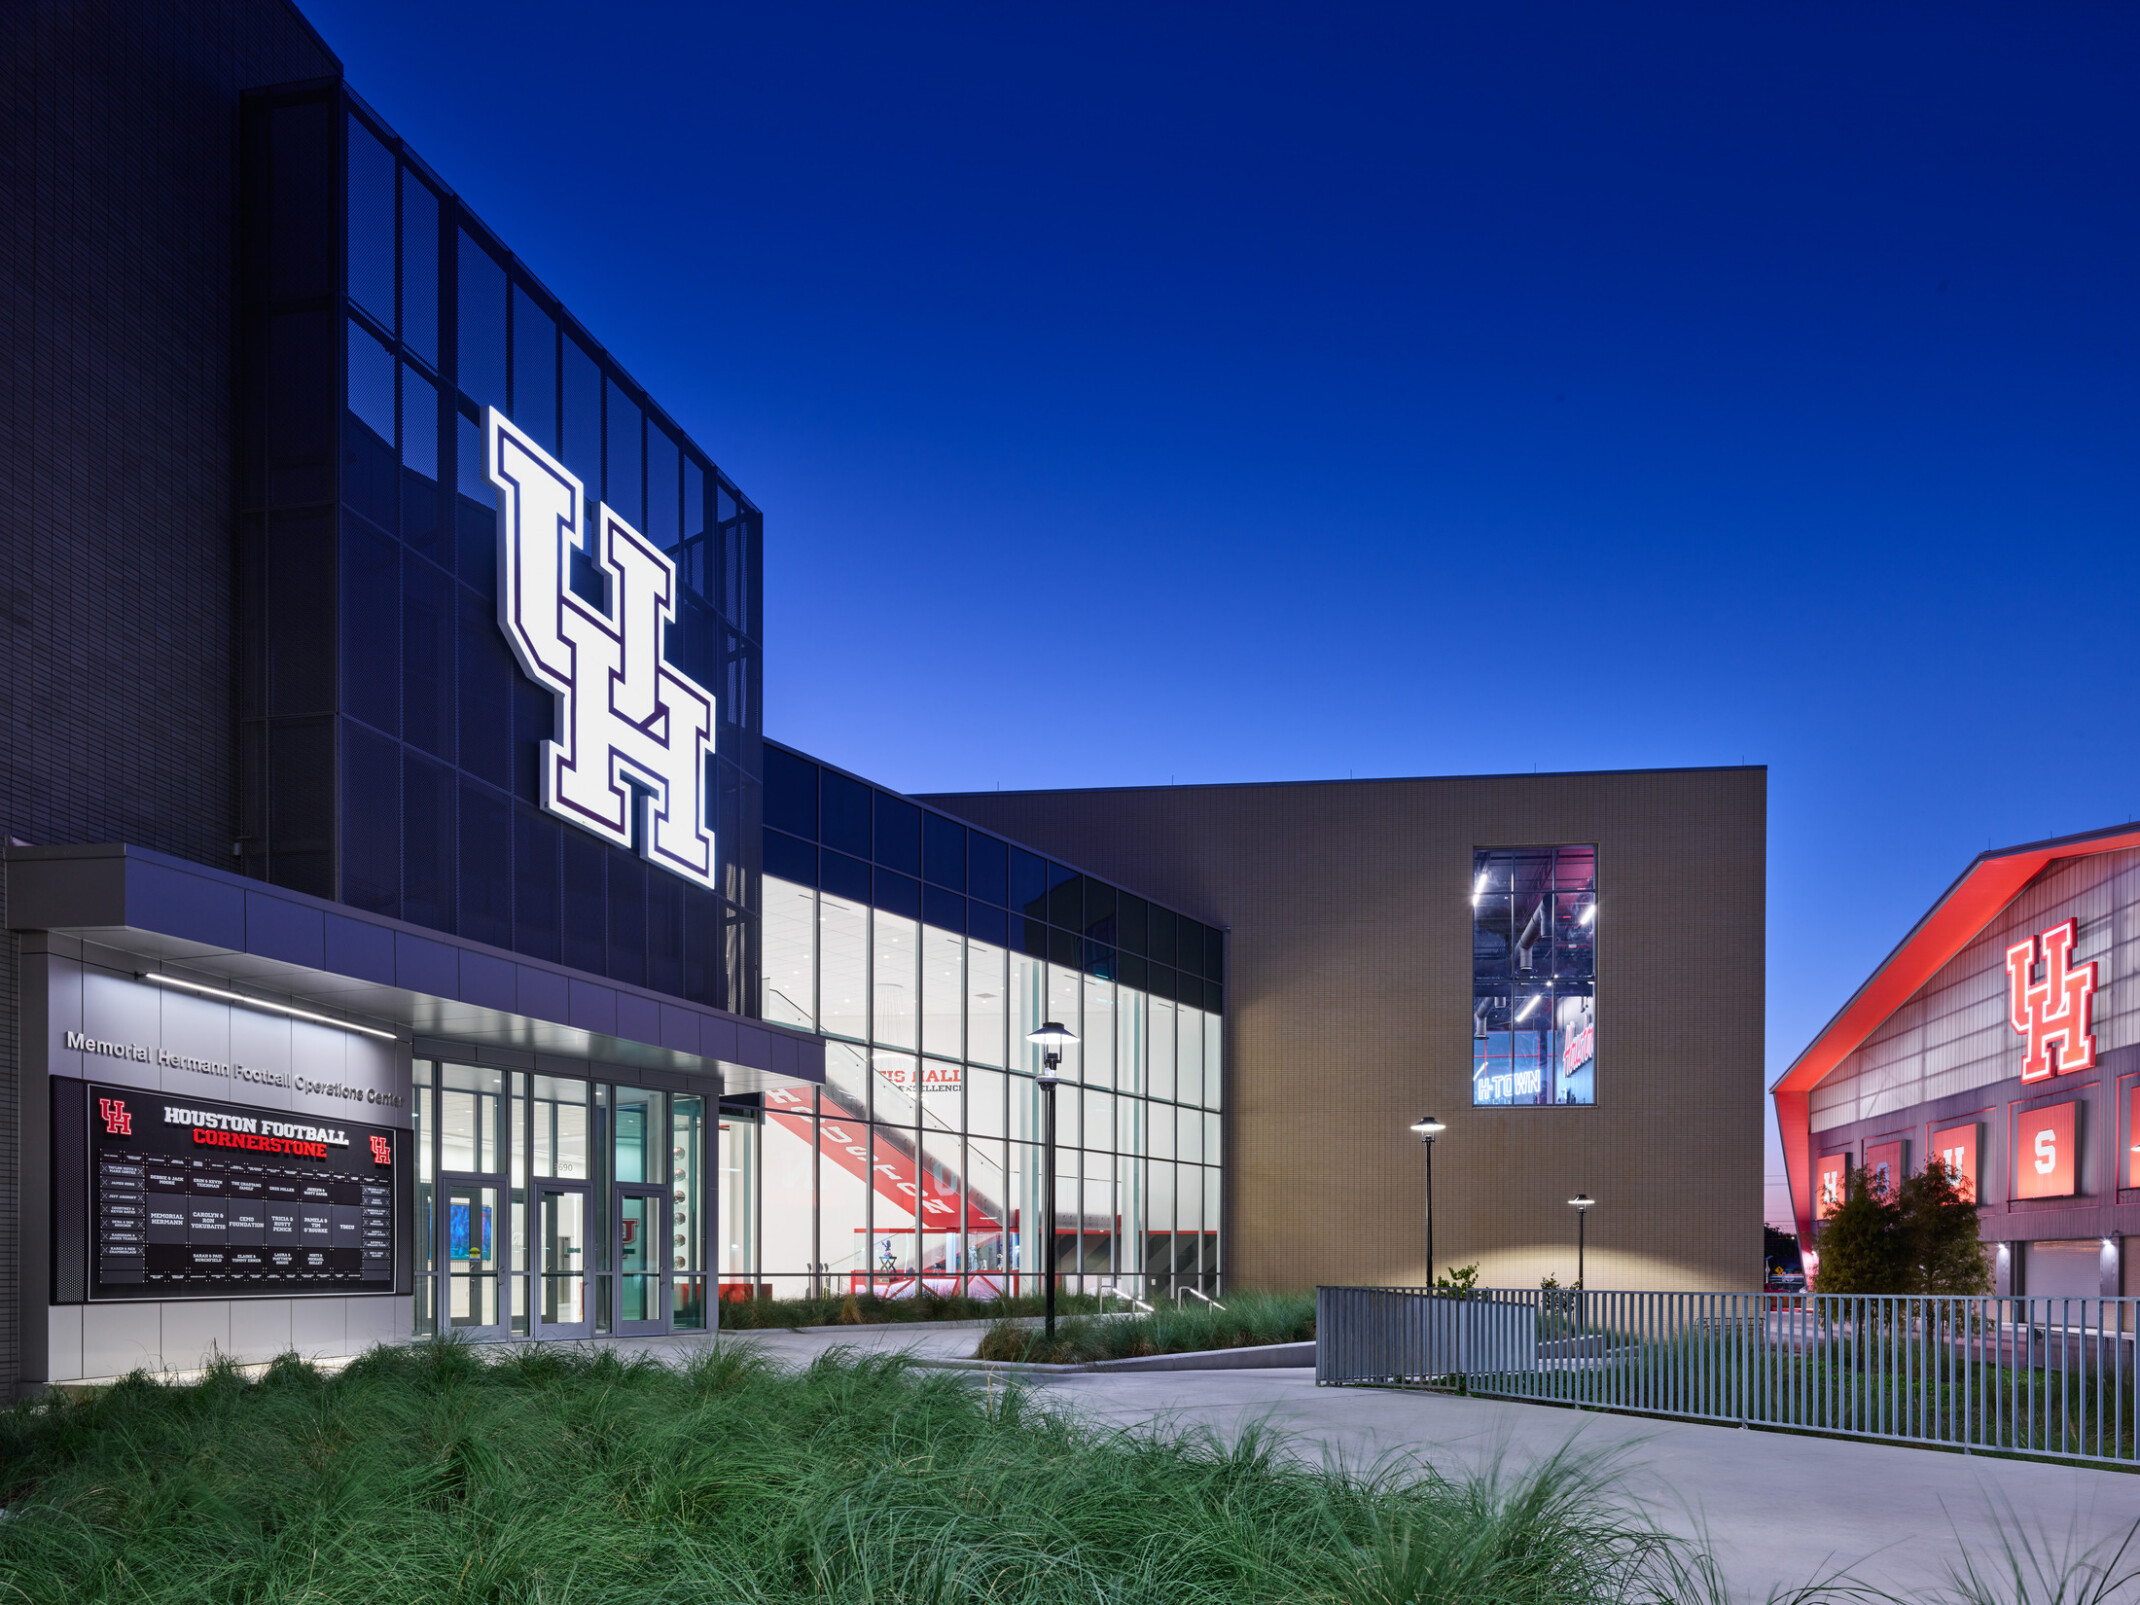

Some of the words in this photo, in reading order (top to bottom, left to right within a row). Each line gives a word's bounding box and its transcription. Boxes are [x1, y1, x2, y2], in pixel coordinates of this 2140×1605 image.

[66, 1030, 152, 1064] Memorial
[157, 1047, 230, 1078] Hermann
[233, 1064, 291, 1088] Football
[294, 1073, 364, 1102] Operations
[366, 1087, 405, 1108] Center
[1478, 1069, 1540, 1100] H-TOWN
[100, 1098, 132, 1135] UH
[164, 1107, 257, 1134] HOUSTON
[261, 1120, 349, 1146] FOOTBALL
[193, 1128, 327, 1158] CORNERSTONE
[370, 1135, 391, 1164] UH
[2035, 1129, 2056, 1174] S
